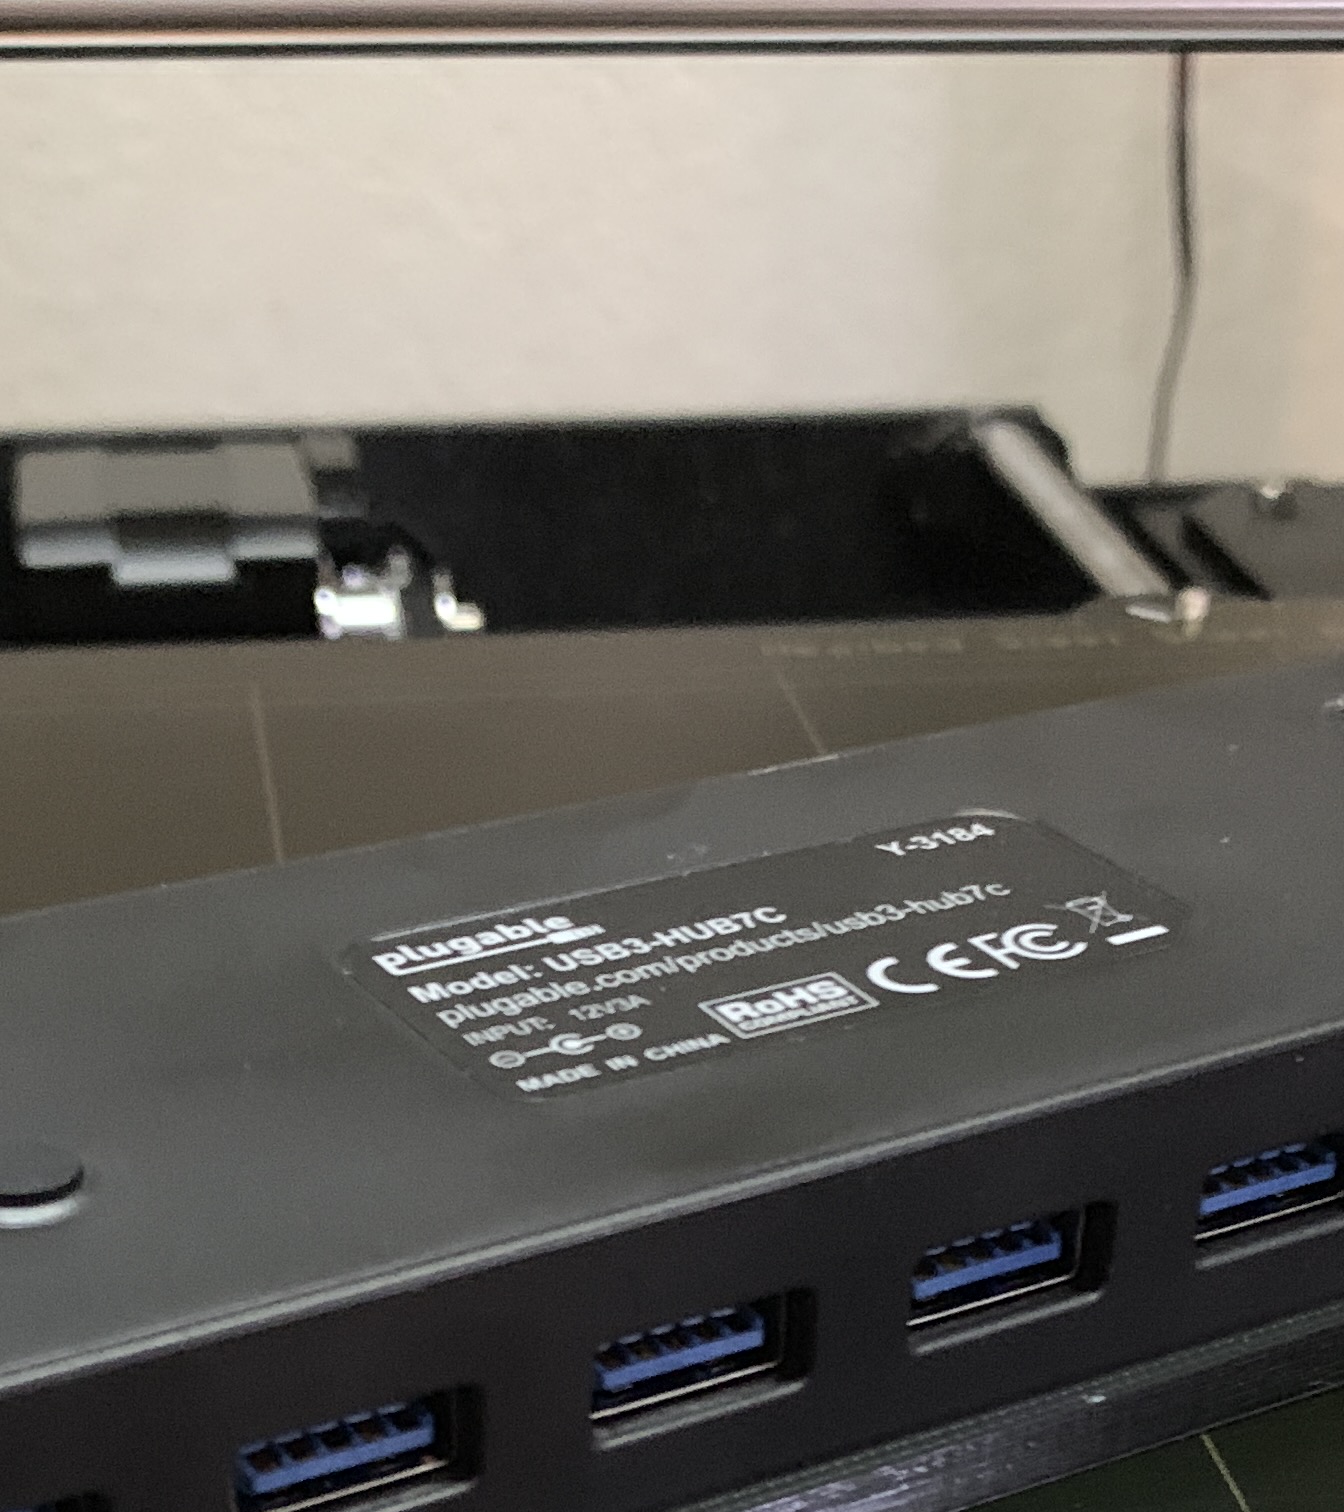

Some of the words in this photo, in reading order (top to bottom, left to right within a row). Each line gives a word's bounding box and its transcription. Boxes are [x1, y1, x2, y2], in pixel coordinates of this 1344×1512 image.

[875, 822, 995, 856] Y-3184
[371, 915, 576, 977] plugable
[407, 964, 544, 1003] Model:
[542, 906, 787, 972] USB3-HUB7C
[436, 882, 1011, 1029] plugable.com/products/usb3-hub7c
[715, 979, 849, 1023] RoHS
[515, 1063, 602, 1092] MADE
[605, 1054, 639, 1071] IN
[644, 1033, 732, 1061] CHINA
